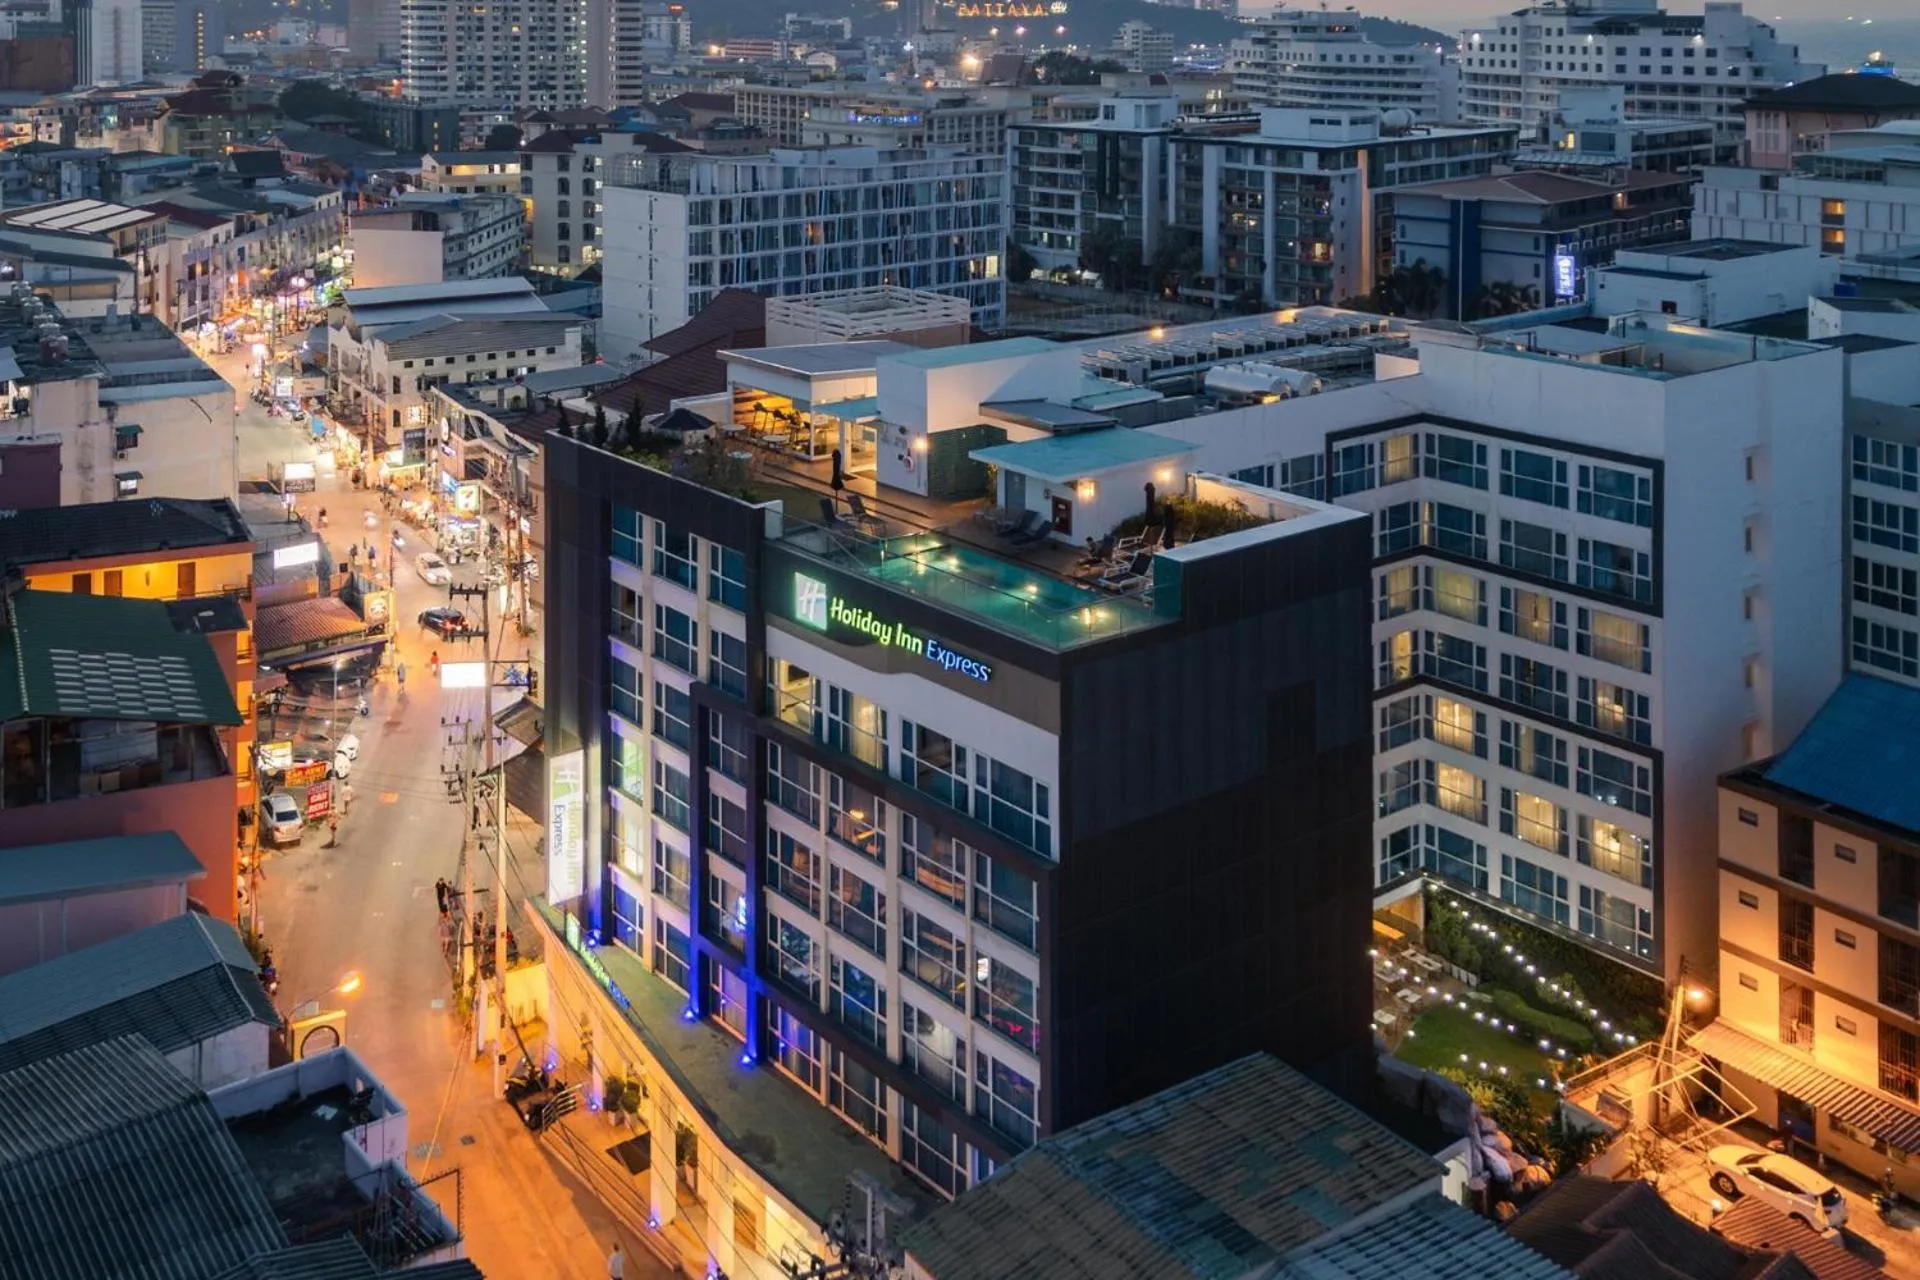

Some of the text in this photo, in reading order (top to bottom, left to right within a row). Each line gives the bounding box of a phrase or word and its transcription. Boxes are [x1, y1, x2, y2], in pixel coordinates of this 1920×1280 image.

[957, 3, 1048, 17] PATTAYA
[831, 596, 990, 682] Holiday Inn Express
[553, 804, 566, 857] Express
